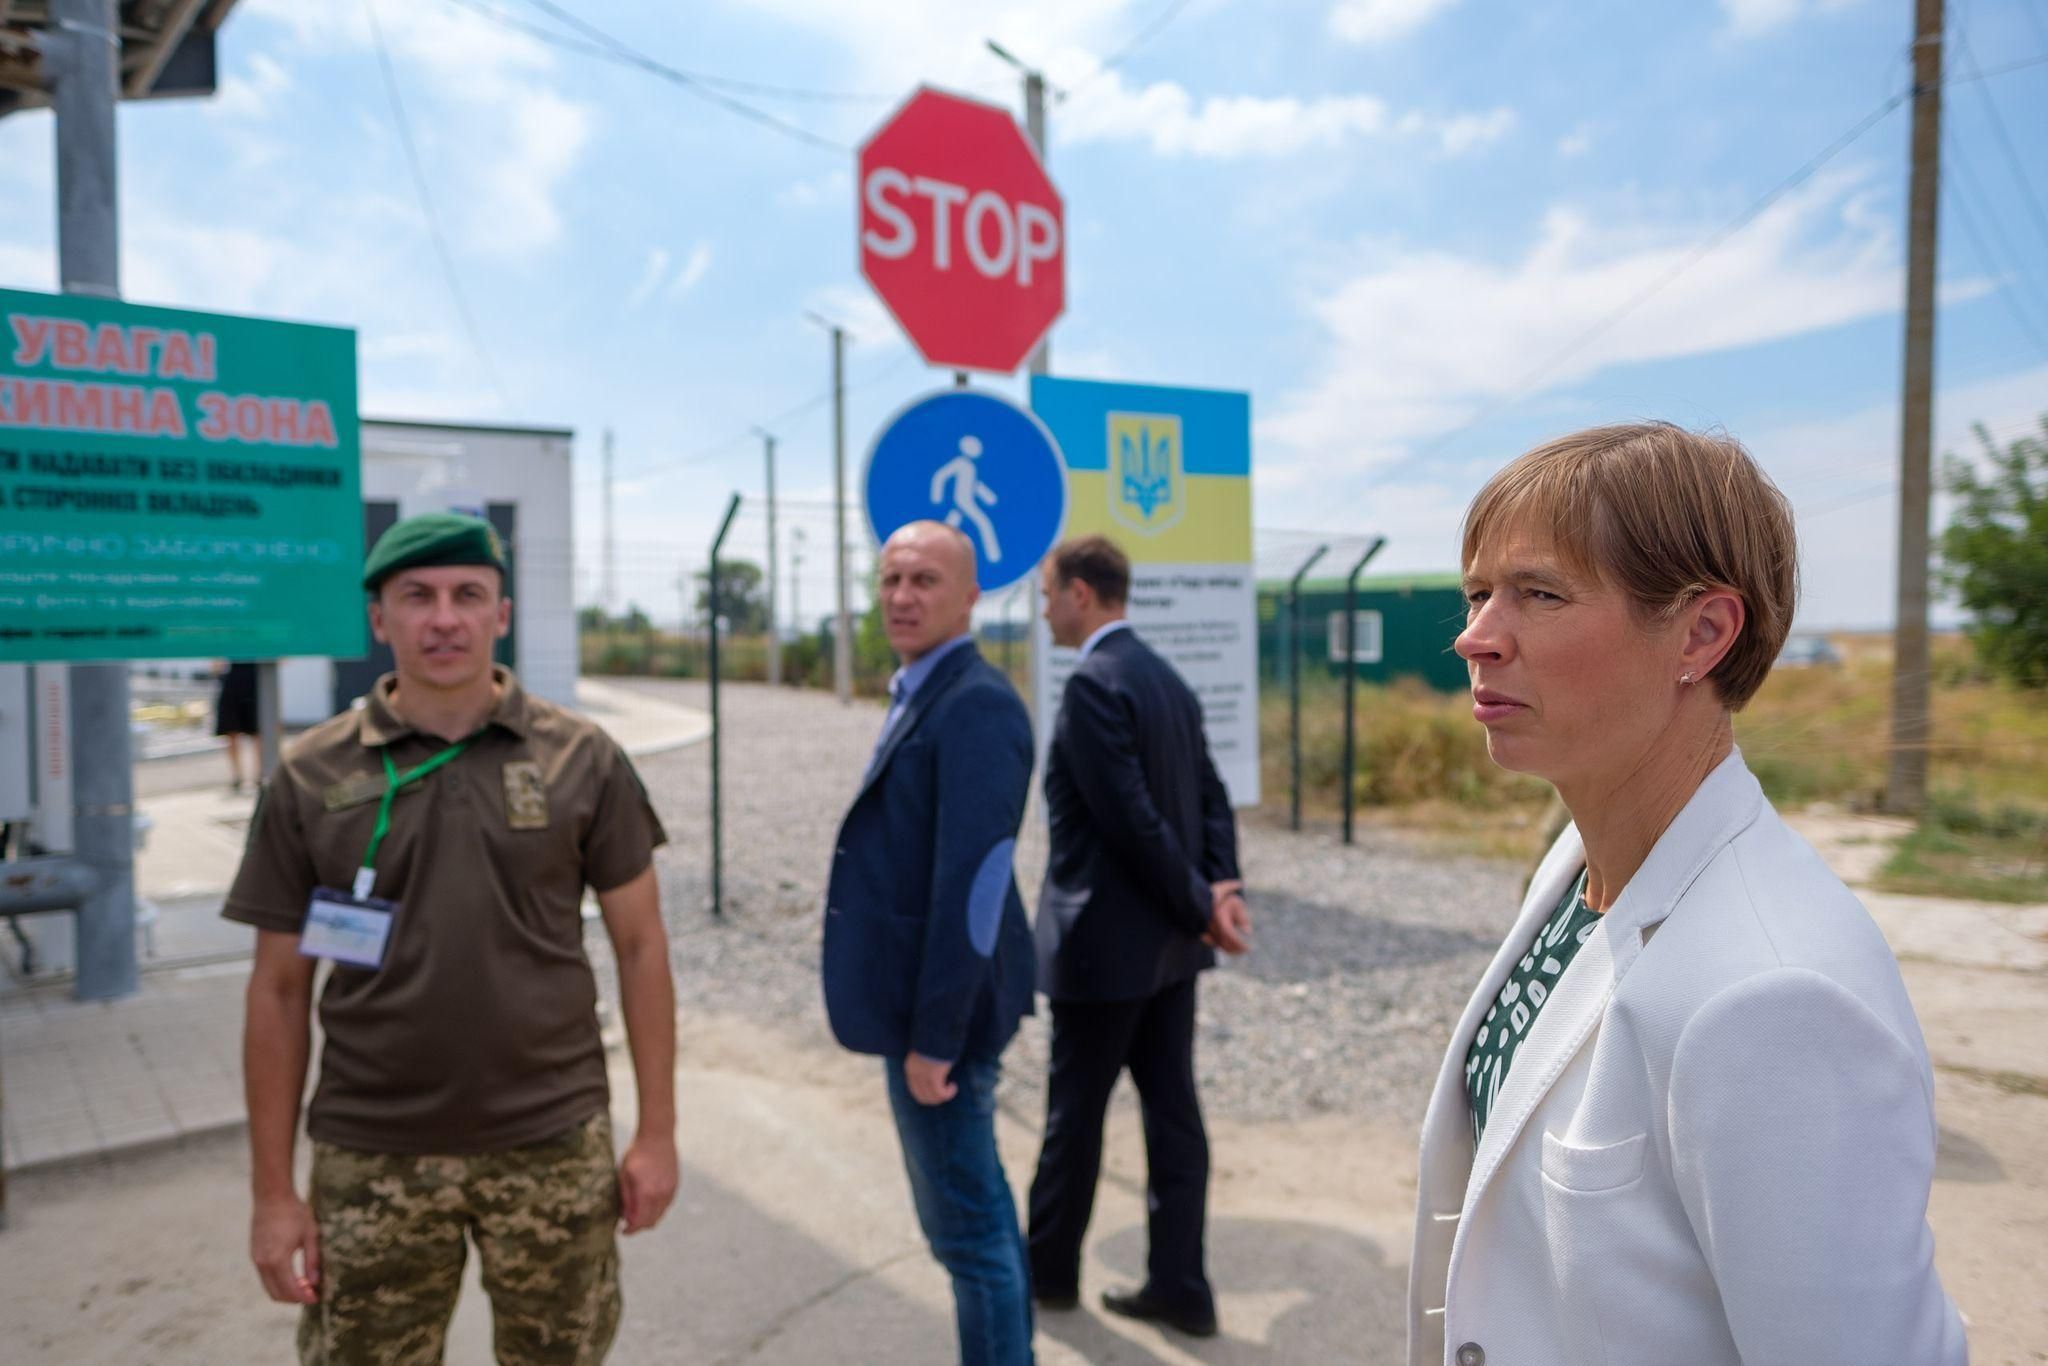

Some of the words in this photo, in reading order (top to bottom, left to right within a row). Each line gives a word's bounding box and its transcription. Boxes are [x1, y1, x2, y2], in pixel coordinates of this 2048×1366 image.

[863, 167, 1060, 286] STOP
[8, 314, 217, 381] УВАГА!
[196, 390, 339, 447] ЗОНА
